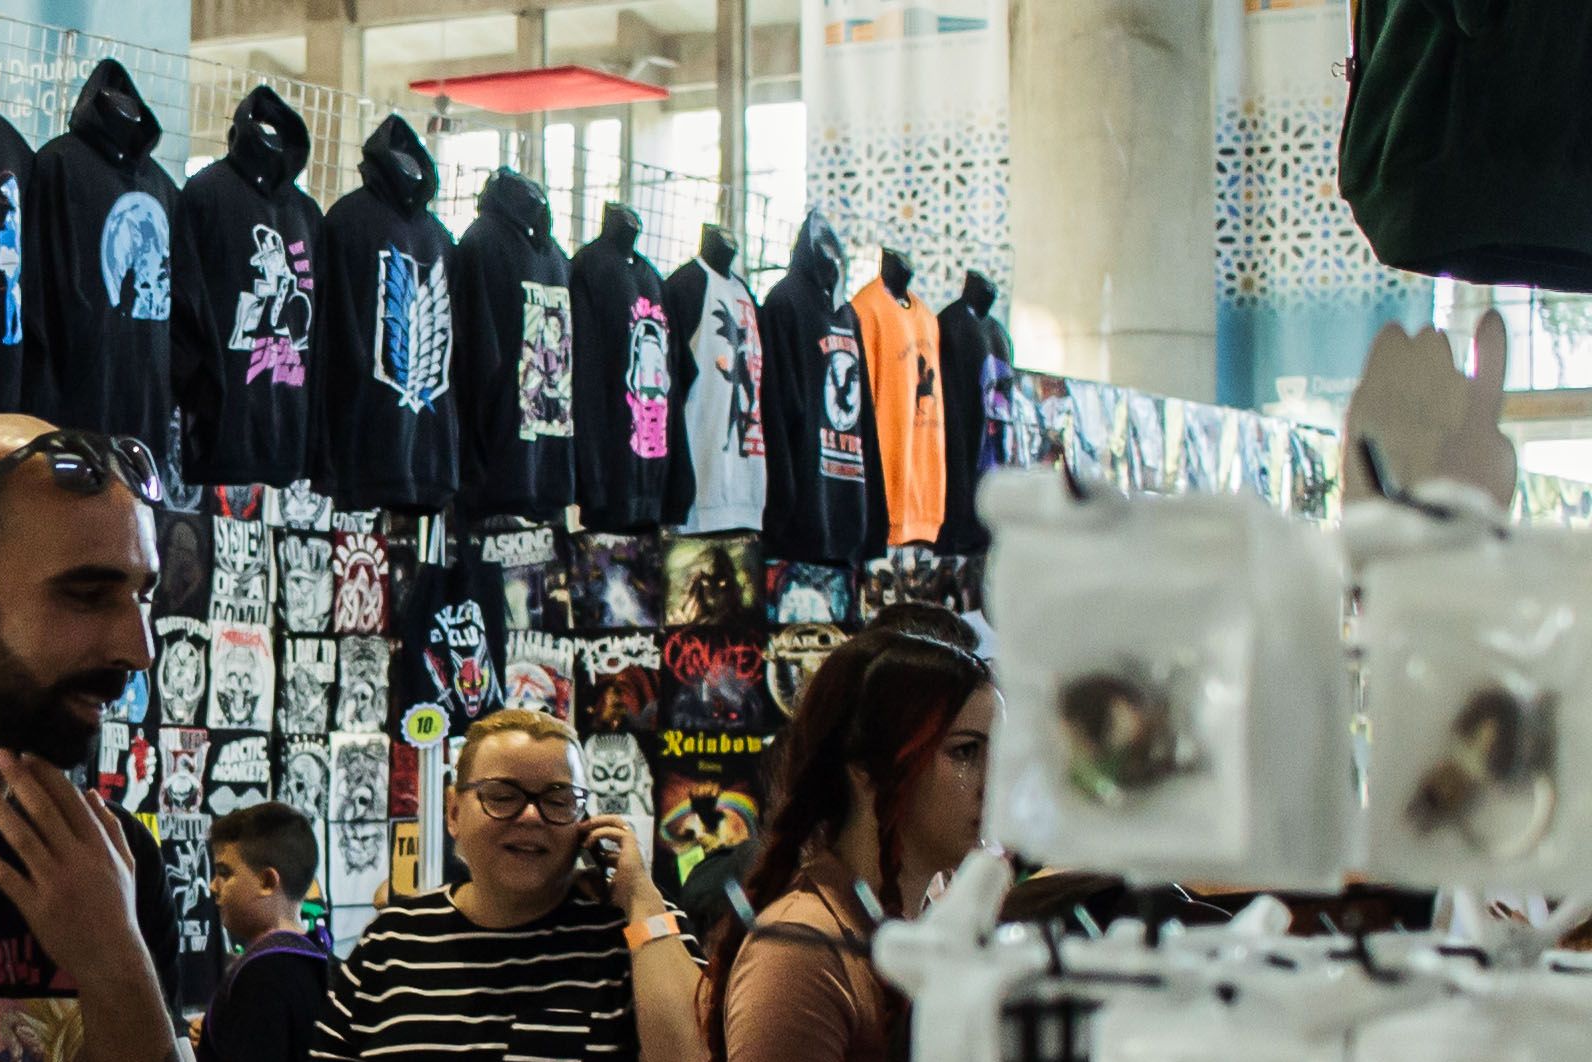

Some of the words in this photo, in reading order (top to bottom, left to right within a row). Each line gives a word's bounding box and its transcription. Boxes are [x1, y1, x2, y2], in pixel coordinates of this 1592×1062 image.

[482, 528, 554, 562] ASKING
[447, 625, 481, 647] CLU
[219, 736, 268, 763] ARCTIC
[662, 729, 762, 757] Rainbow
